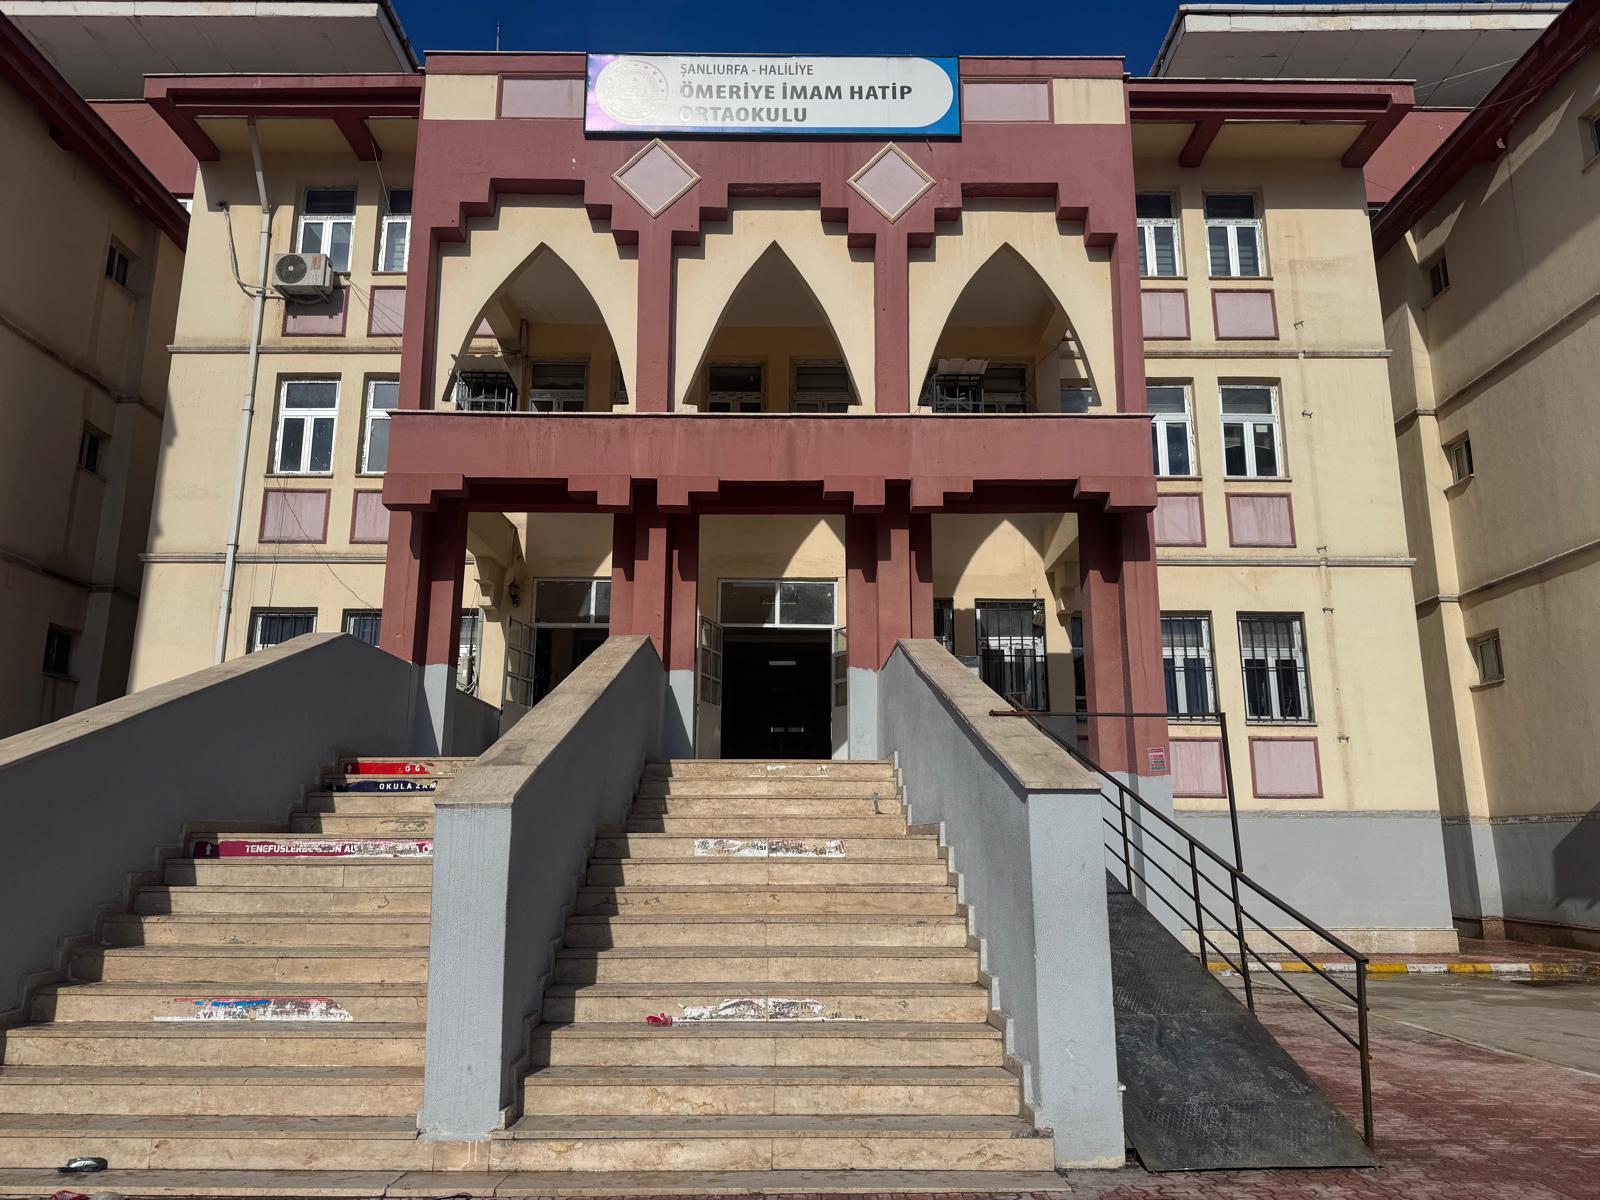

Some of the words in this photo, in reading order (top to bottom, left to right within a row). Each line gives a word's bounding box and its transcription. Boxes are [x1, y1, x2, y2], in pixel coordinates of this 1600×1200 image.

[680, 63, 749, 77] ŞANLIURFA
[759, 62, 814, 76] HALİLİYE
[680, 81, 775, 100] ÖMERİYE
[782, 82, 843, 100] İMAM
[849, 82, 913, 100] HATİP
[679, 105, 807, 122] ORTAOKULU
